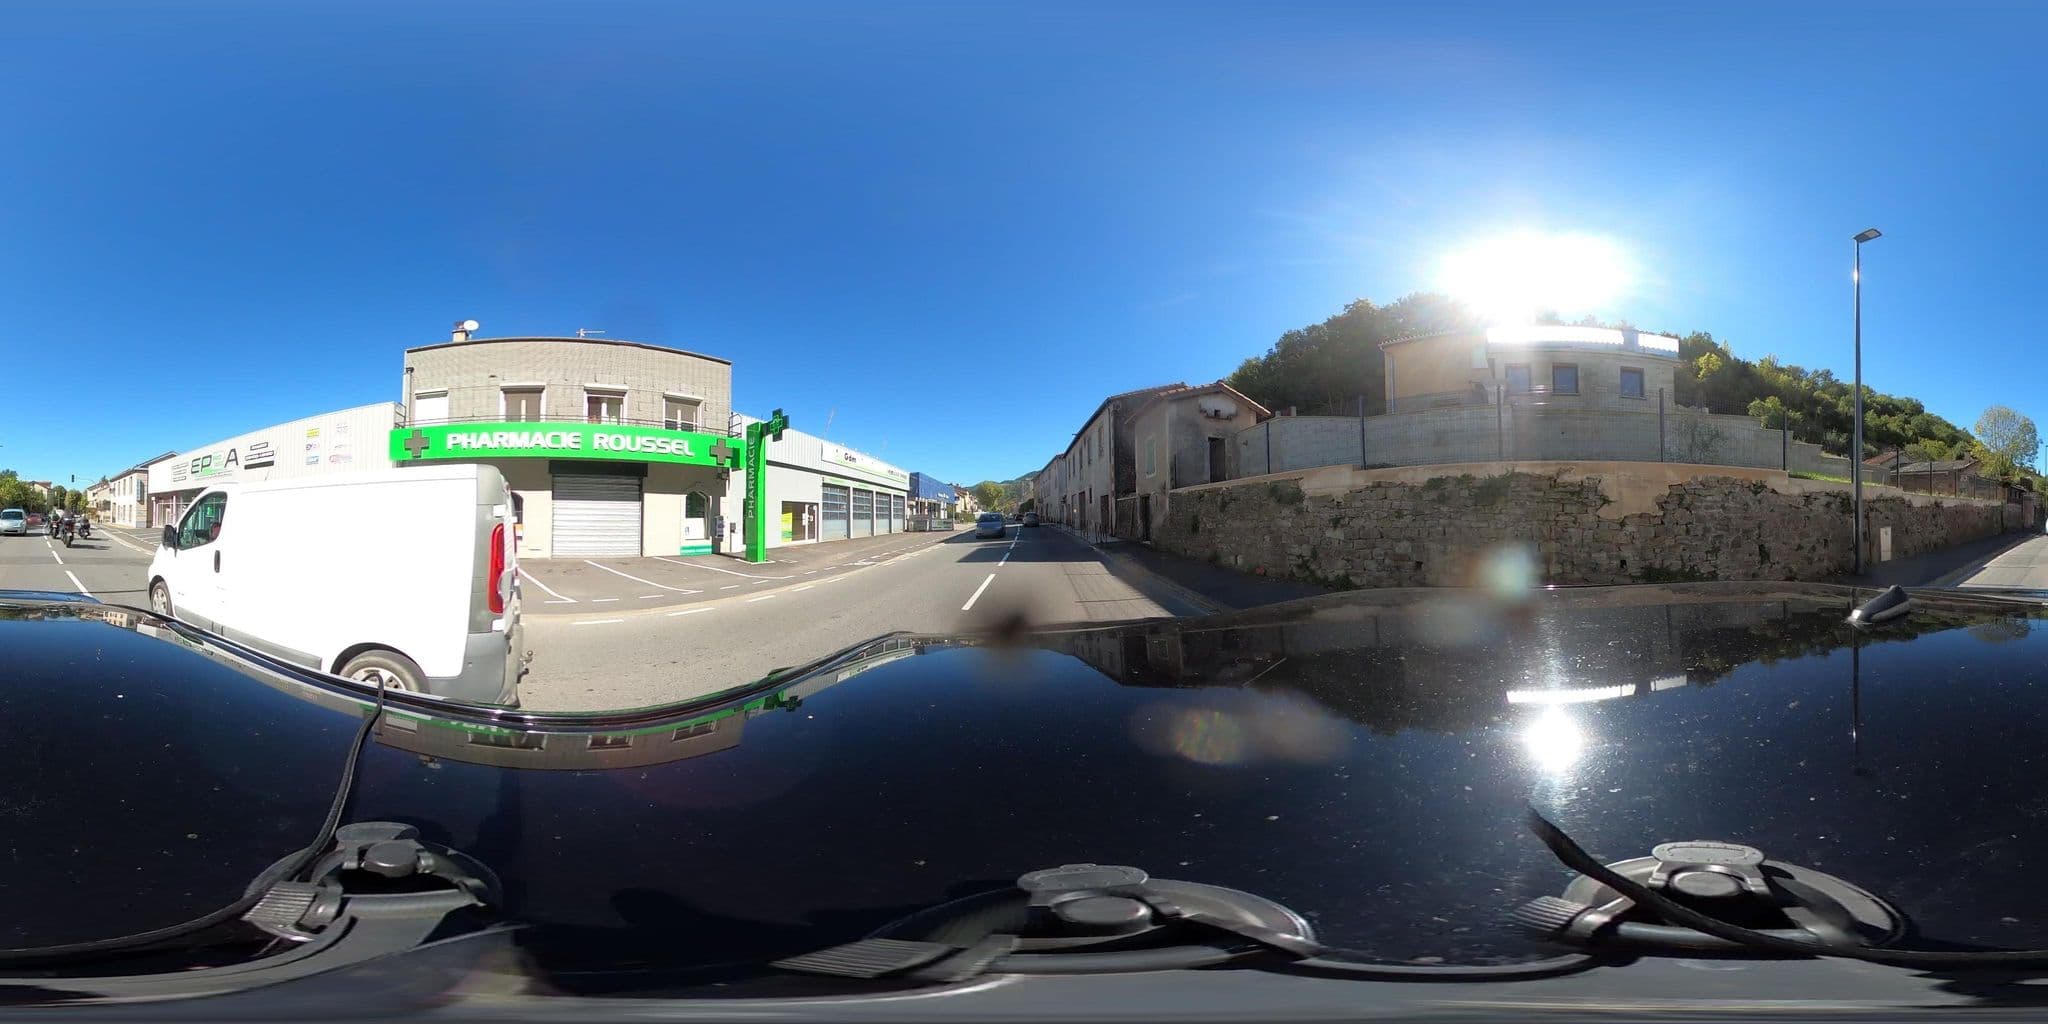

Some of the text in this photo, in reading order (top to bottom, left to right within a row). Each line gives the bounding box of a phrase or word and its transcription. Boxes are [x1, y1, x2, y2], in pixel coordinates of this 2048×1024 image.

[447, 432, 695, 457] PHARMACIE ROUSSEL
[748, 437, 756, 518] PHARMACIE
